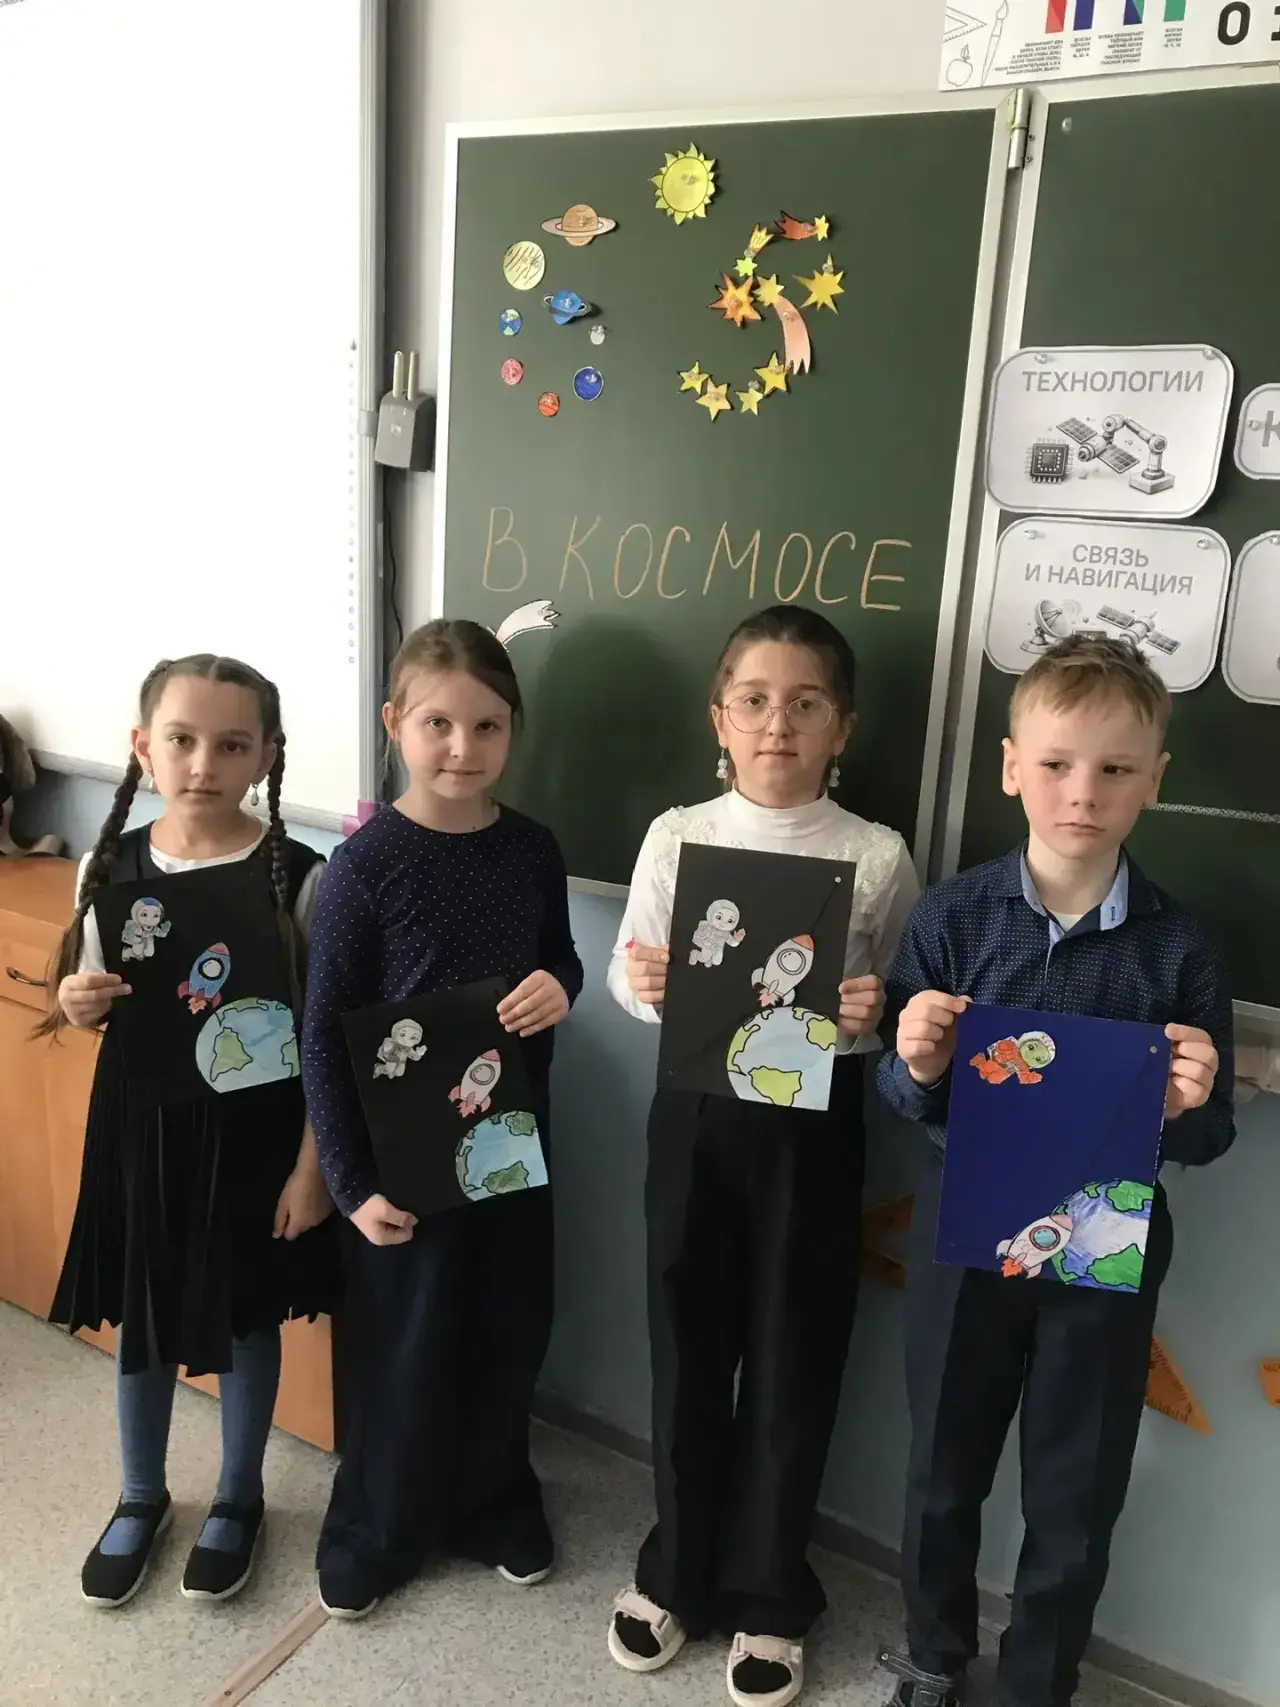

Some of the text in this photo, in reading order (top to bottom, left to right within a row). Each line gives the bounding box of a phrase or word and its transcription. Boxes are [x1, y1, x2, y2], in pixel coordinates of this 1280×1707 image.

[1022, 370, 1204, 393] ТЕХНОЛОГИИ
[482, 506, 912, 611] В КОСМОСЕ
[1072, 544, 1149, 568] СВЯЗЬ
[1024, 563, 1194, 595] И НАВИГАЦИЯ
